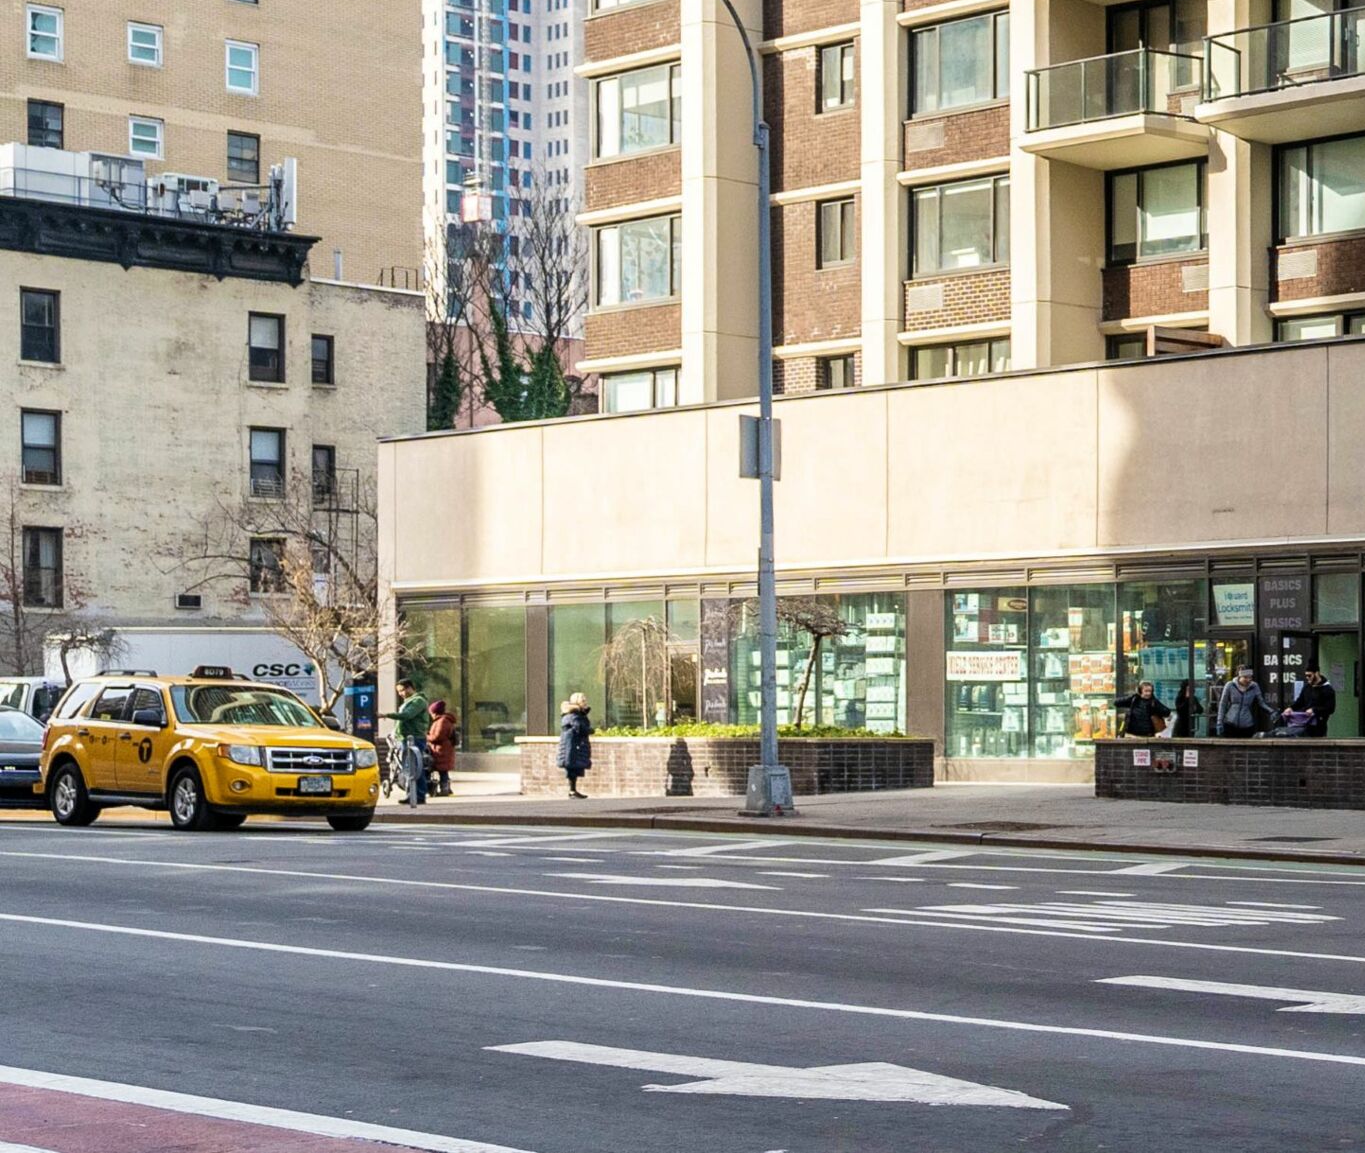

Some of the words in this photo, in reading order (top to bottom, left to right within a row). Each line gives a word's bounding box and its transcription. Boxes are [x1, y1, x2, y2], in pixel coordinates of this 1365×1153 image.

[1264, 580, 1301, 591] BASICS
[1270, 598, 1296, 608] PLUS
[1264, 617, 1302, 629] BASICS
[1263, 654, 1303, 666] BAICS
[252, 663, 301, 677] CSC
[360, 695, 369, 707] P
